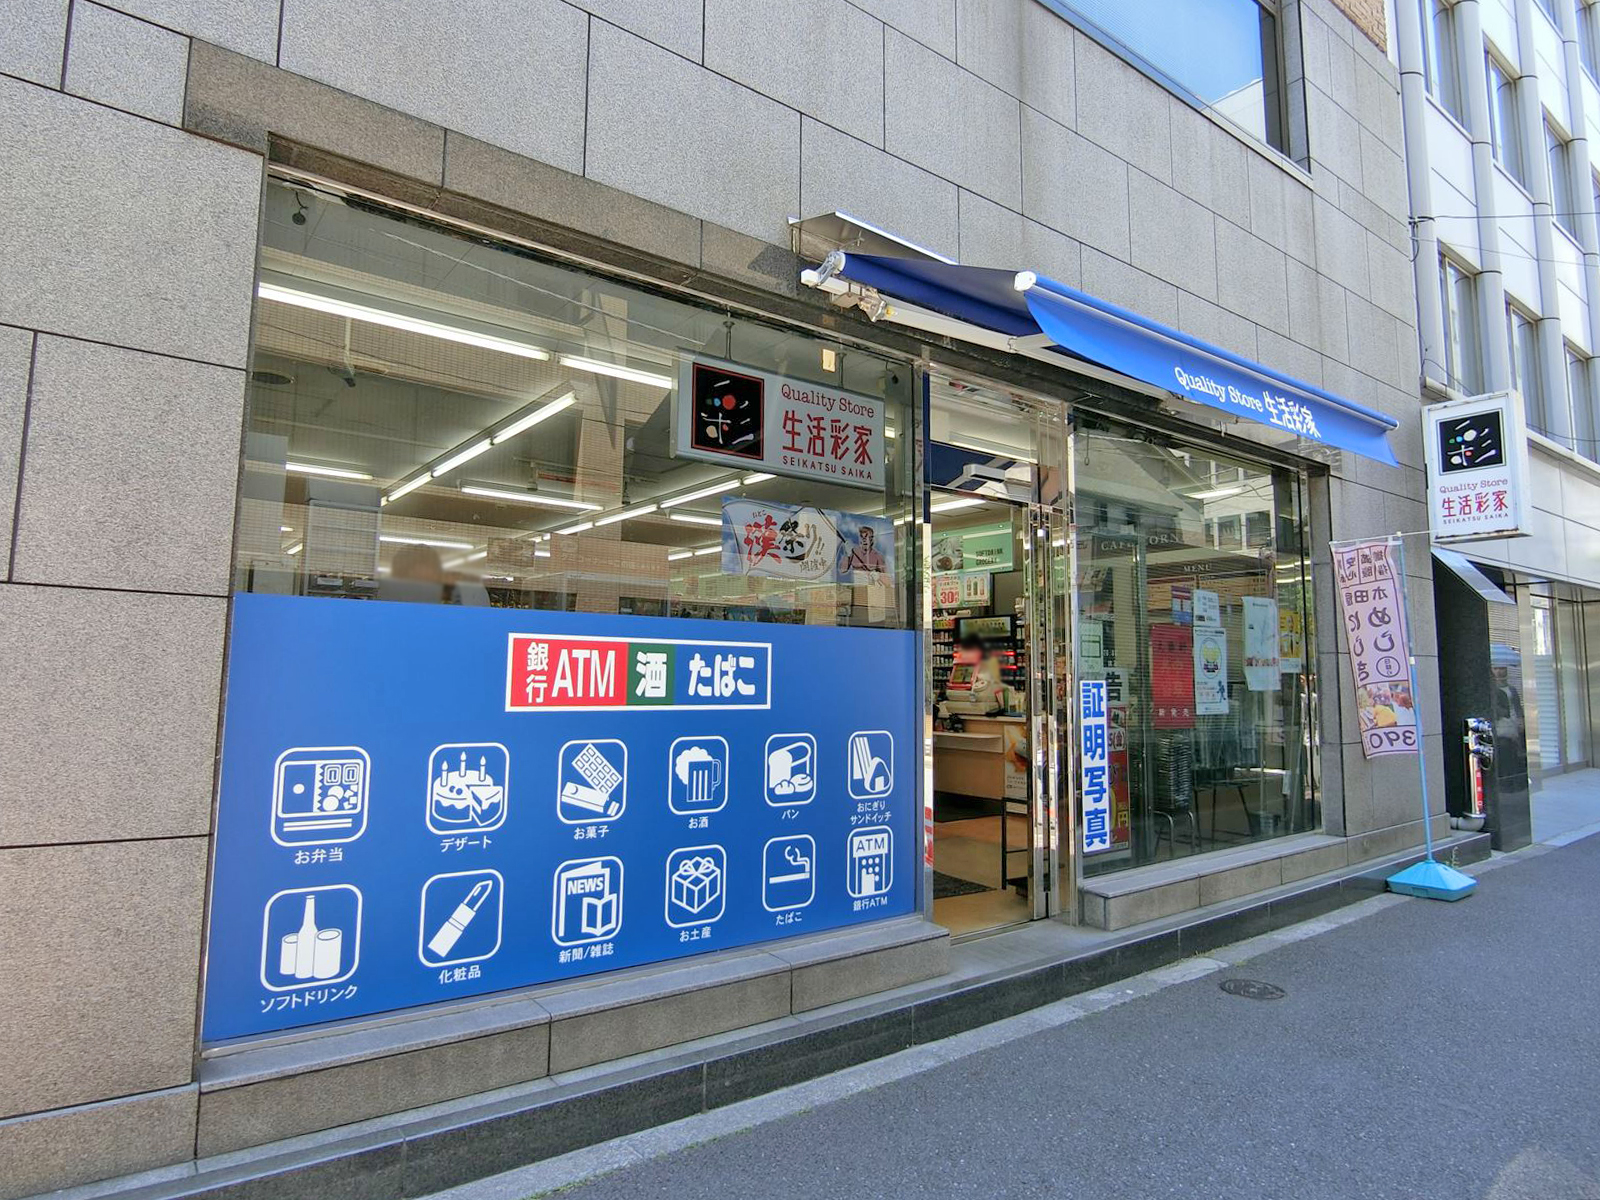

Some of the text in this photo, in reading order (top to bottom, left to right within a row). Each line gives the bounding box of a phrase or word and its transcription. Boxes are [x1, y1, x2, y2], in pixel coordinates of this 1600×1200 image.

[781, 384, 875, 418] Quality Store
[1174, 367, 1321, 438] Quality Store 生活彩家
[782, 410, 873, 466] 生活彩家
[782, 455, 873, 480] SEIKATSU SAIKA
[1439, 478, 1508, 493] Quality Store
[1442, 490, 1509, 518] 生活彩家
[1443, 512, 1509, 525] SEIKATSU SAIKA
[1183, 563, 1213, 573] MENU
[526, 642, 549, 704] 銀行
[551, 648, 616, 698] ATM
[635, 651, 667, 698] 酒
[688, 653, 756, 698] たばこ
[1082, 682, 1108, 848] 証明写真
[781, 809, 799, 820] パン
[856, 802, 886, 813] おにぎり
[688, 816, 709, 829] お酒
[850, 812, 892, 826] サンドイッチ
[573, 825, 610, 840] お菓子
[440, 835, 493, 853] デザート
[856, 836, 885, 853] ATM
[294, 847, 344, 865] お弁当
[567, 876, 605, 895] NEWS
[853, 897, 888, 911] 銀行ATM
[775, 911, 803, 926] たばこ
[679, 925, 712, 942] お土産
[558, 942, 614, 964] 新聞/雑誌
[438, 965, 482, 985] 化粧品
[260, 984, 358, 1013] ソフトドリンク
